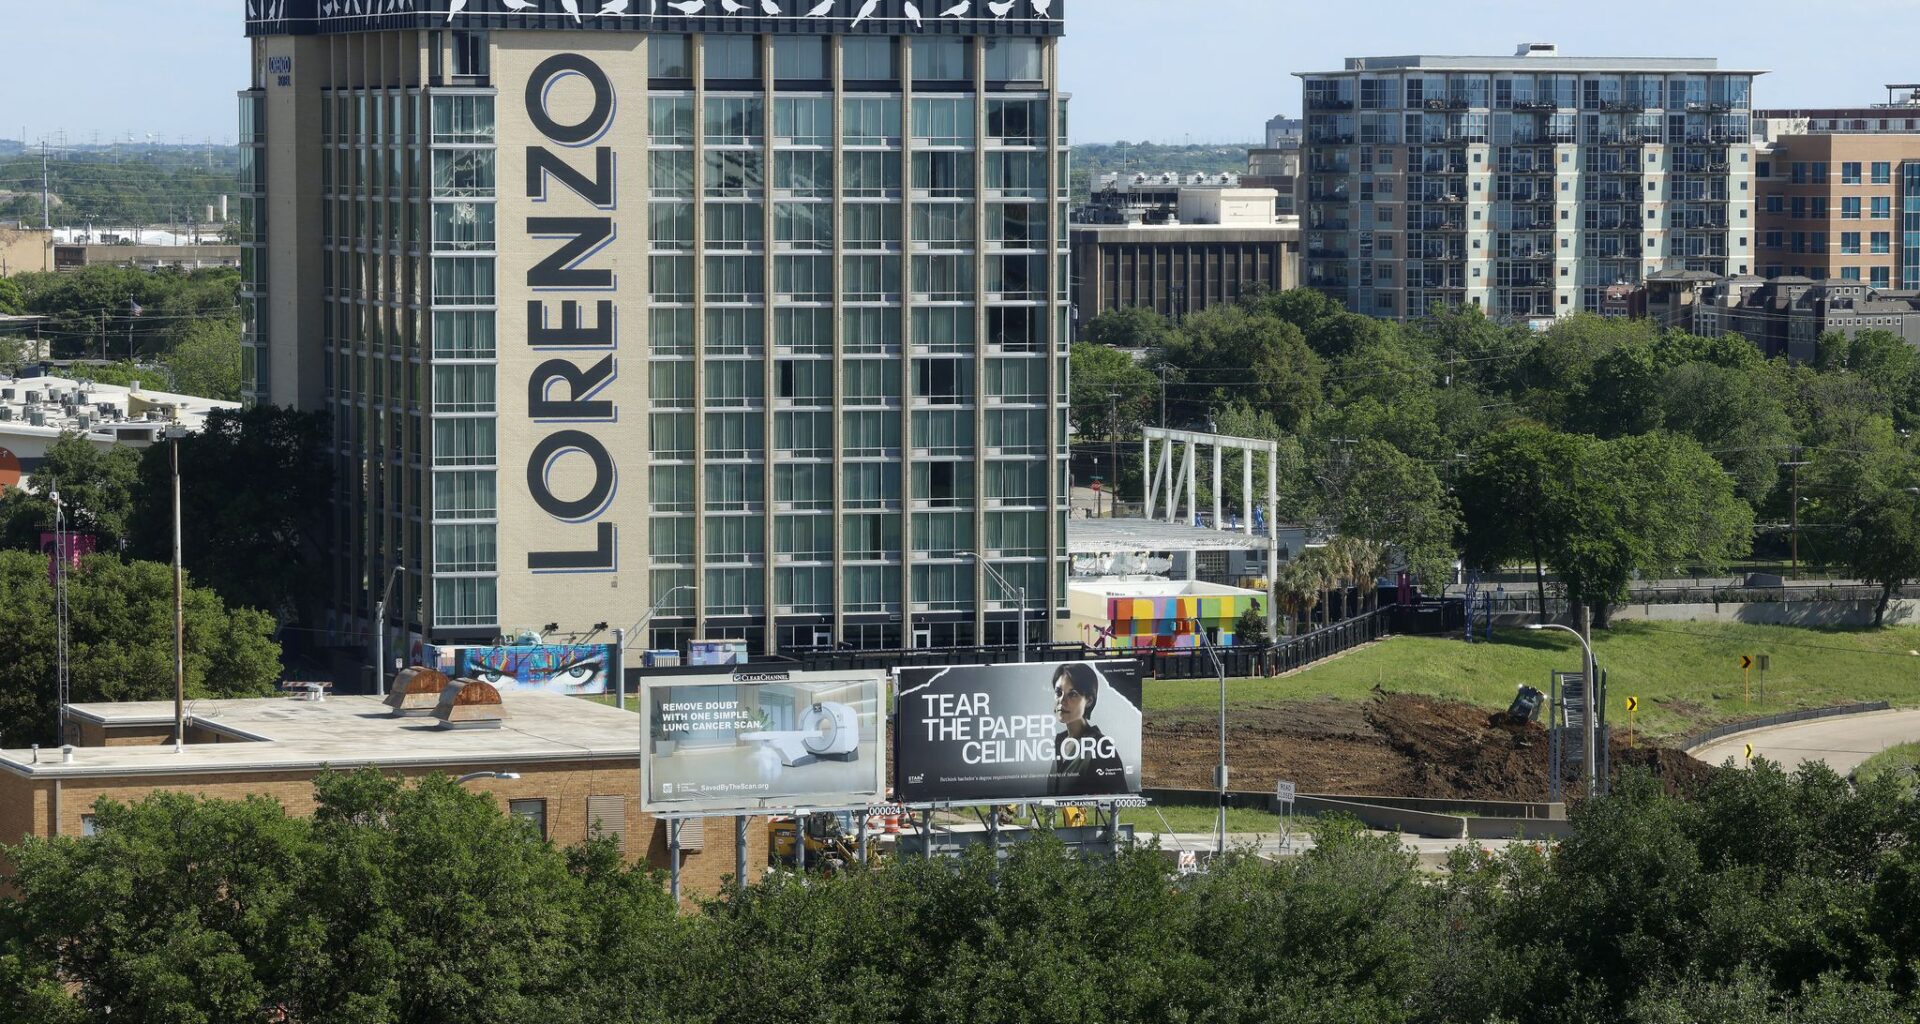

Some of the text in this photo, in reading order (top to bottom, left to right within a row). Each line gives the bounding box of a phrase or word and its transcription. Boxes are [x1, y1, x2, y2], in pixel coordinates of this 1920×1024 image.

[525, 53, 617, 573] LORENZO
[663, 701, 739, 711] REMOVE DOUBT
[922, 693, 990, 717] TEAR
[663, 711, 748, 722] WITH ONE SIMPLE
[663, 720, 763, 732] LUNG CANCER SCAN.
[922, 714, 1057, 741] THE PAPER
[962, 736, 1116, 764] CEILING.ORG
[701, 784, 769, 793] SavedByTheScan.org
[1115, 799, 1147, 808] 000025
[869, 806, 900, 816] 000024
